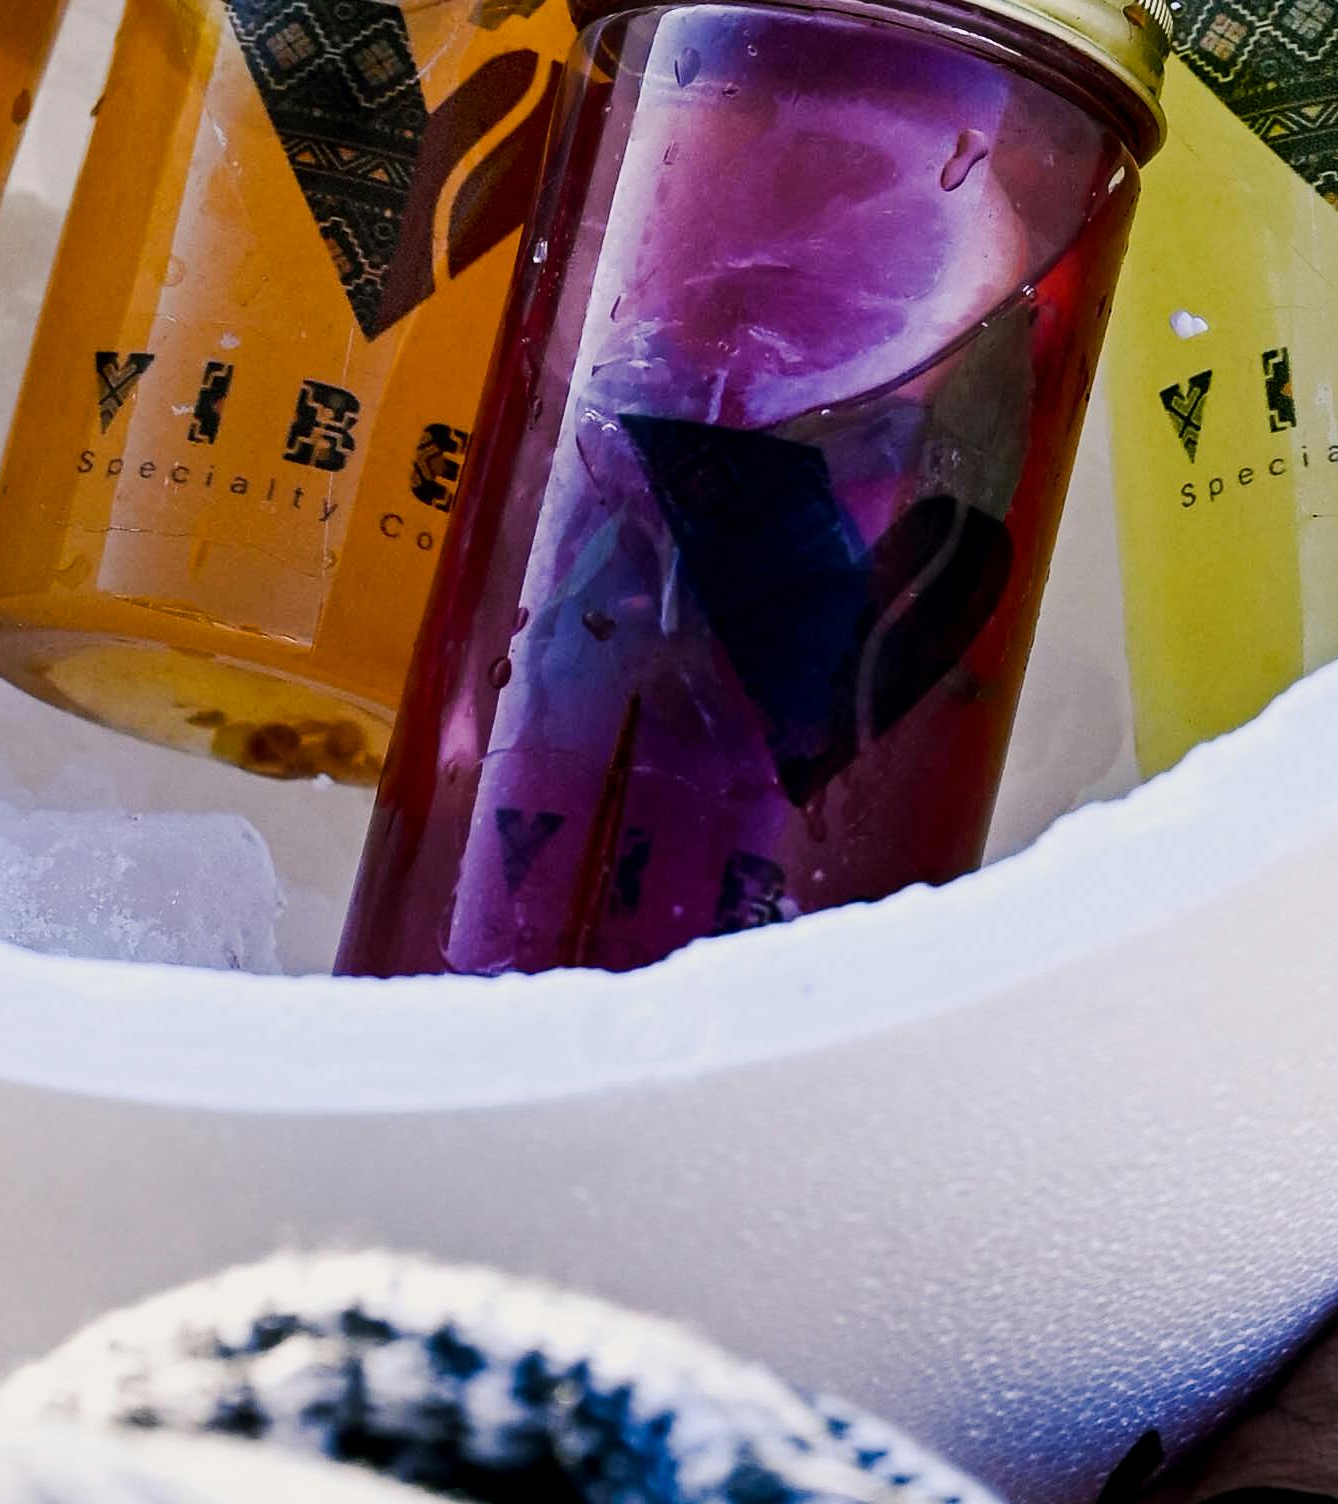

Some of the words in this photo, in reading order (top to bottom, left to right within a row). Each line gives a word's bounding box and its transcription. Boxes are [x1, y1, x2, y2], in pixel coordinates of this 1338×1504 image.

[77, 450, 338, 521] Specialty
[95, 351, 472, 513] VIBE
[496, 809, 786, 931] VIB
